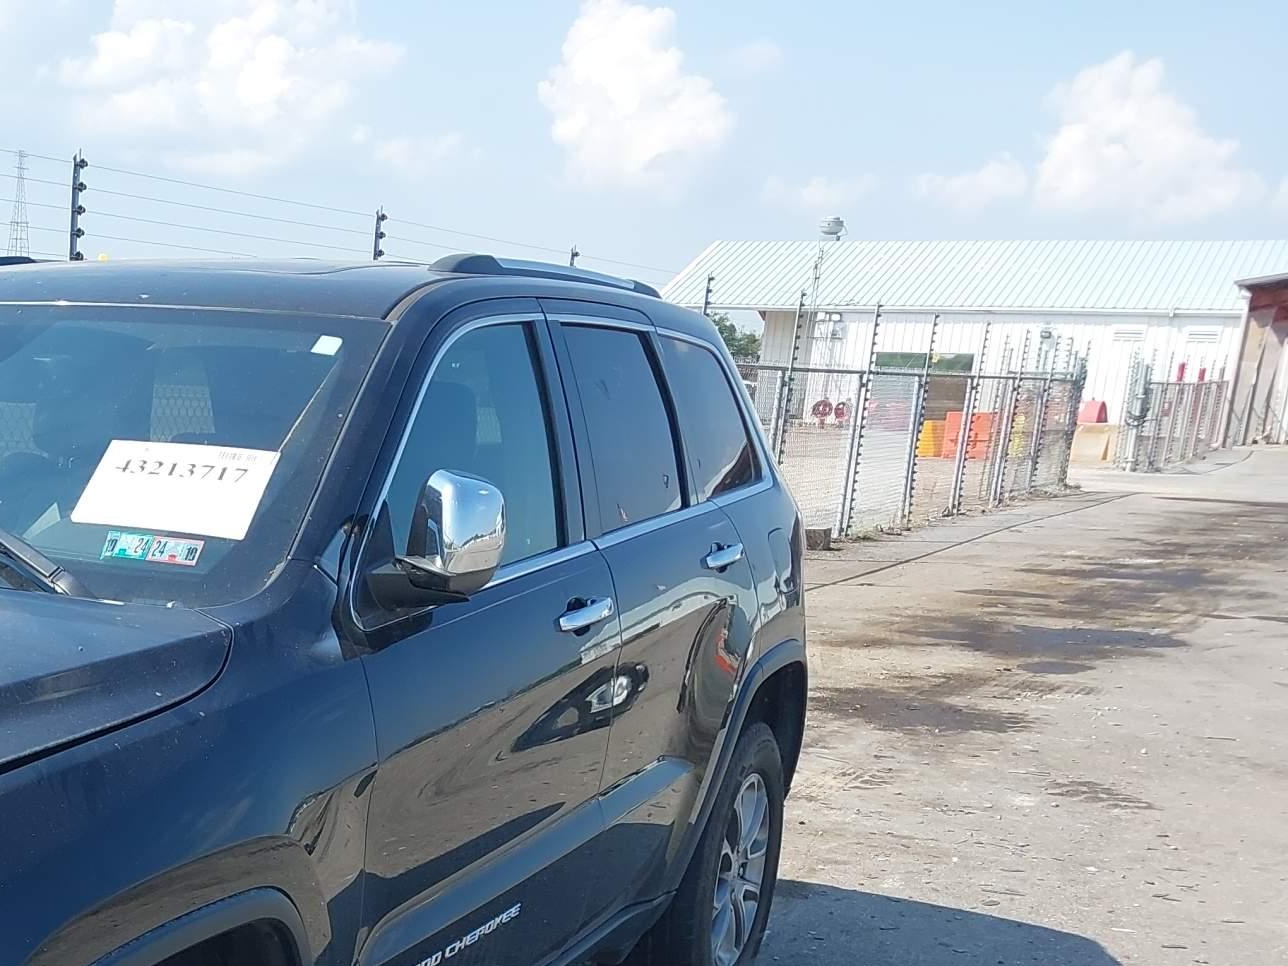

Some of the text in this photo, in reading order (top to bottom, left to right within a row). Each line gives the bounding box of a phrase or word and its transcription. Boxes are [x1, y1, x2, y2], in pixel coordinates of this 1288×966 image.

[115, 458, 250, 483] 43213717
[134, 537, 150, 554] 24
[152, 540, 169, 558] 24
[444, 902, 523, 959] CHEROKEE
